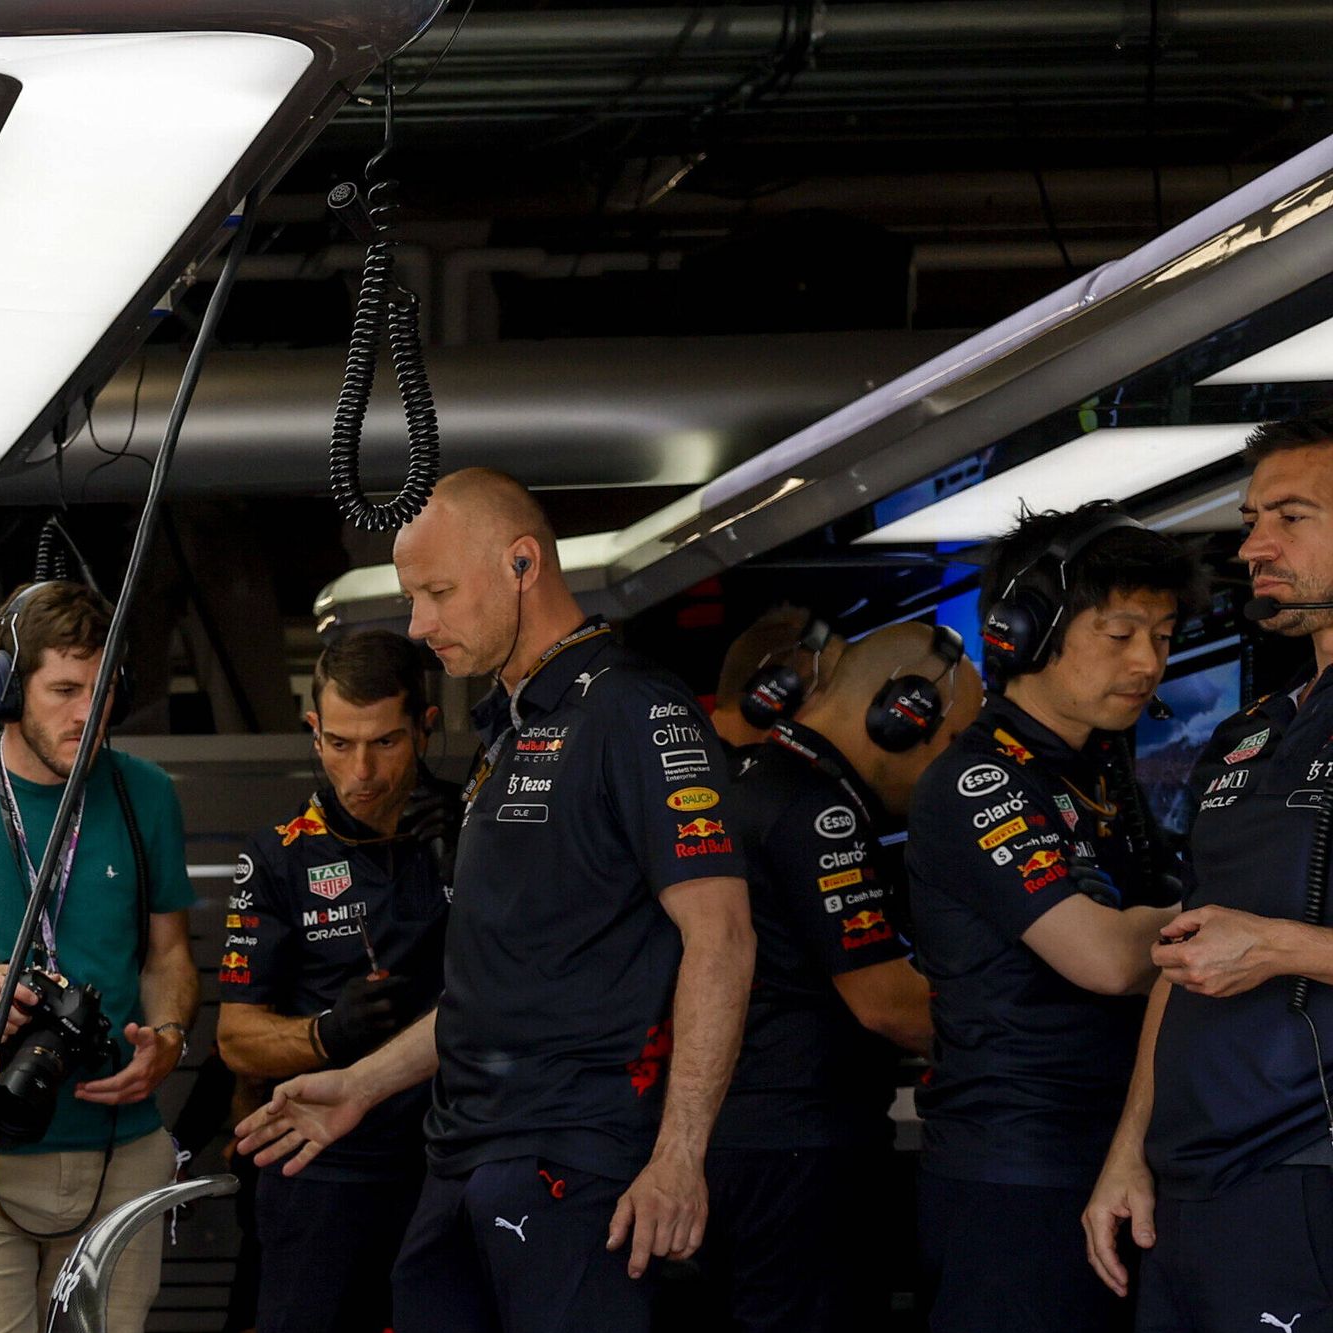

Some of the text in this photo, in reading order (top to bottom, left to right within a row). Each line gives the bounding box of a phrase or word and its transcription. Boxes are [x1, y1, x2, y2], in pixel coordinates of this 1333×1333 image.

[652, 723, 704, 746] citrix
[517, 740, 530, 750] Red
[514, 753, 560, 763] RACING
[665, 767, 689, 776] Hewlett
[666, 773, 697, 782] Enterprise
[520, 775, 552, 792] Tezos
[964, 770, 1002, 790] Esso
[682, 793, 713, 805] RAUCH
[513, 809, 530, 817] OLE
[973, 799, 1024, 829] Claro
[822, 815, 852, 831] Esso
[1041, 832, 1060, 846] App
[675, 837, 733, 858] Red Bull
[819, 850, 864, 870] Claro
[312, 864, 346, 881] TAG
[312, 877, 349, 897] HEUER
[1024, 870, 1059, 894] Red
[846, 892, 869, 905] Cash
[303, 905, 348, 927] Mobil
[232, 970, 251, 984] Bull
